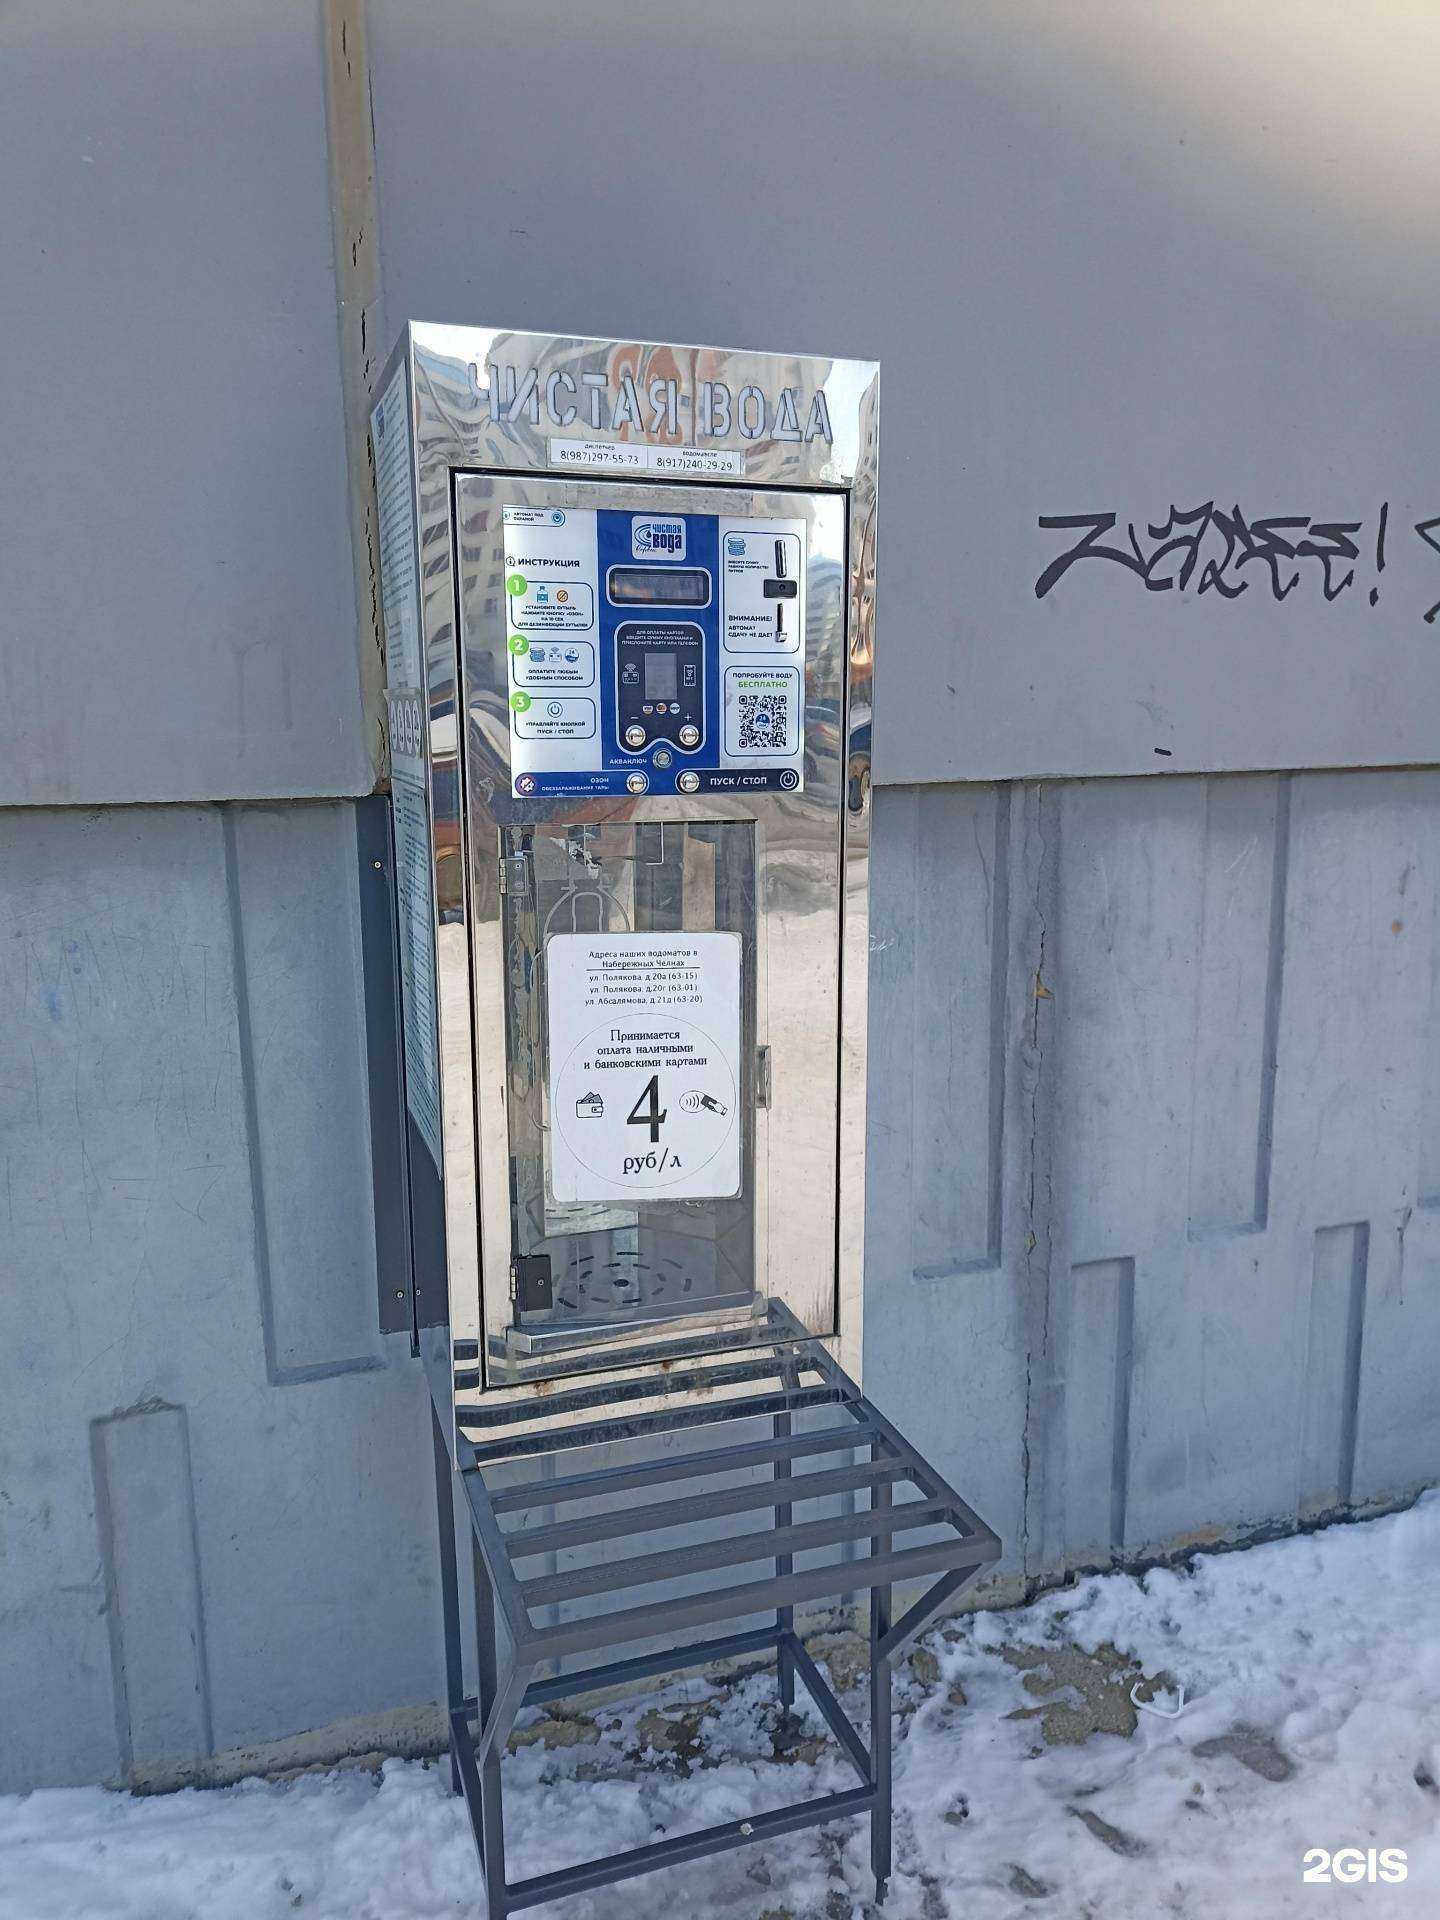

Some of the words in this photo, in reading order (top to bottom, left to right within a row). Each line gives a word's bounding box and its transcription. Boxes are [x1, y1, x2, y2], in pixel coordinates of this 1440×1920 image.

[469, 362, 677, 435] ЧИСТАЯ
[704, 381, 834, 444] ВОДА
[560, 450, 639, 465] 8(987)297-55-73
[656, 457, 733, 471] 8(917)240-29-29
[517, 558, 580, 568] ИНСТРУКЦИЯ
[732, 671, 775, 679] ПОПРОБУЙТЕ
[709, 777, 735, 786] ПУСК
[742, 776, 767, 785] СТОП
[588, 951, 617, 959] Адреса
[602, 961, 654, 970] Набережных
[610, 1029, 680, 1043] Принимается
[597, 1046, 631, 1055] оплата
[636, 1045, 694, 1054] наличными
[594, 1059, 661, 1069] банковскими
[665, 1057, 707, 1068] картами
[627, 1074, 668, 1143] 4
[622, 1147, 682, 1175] руб/л
